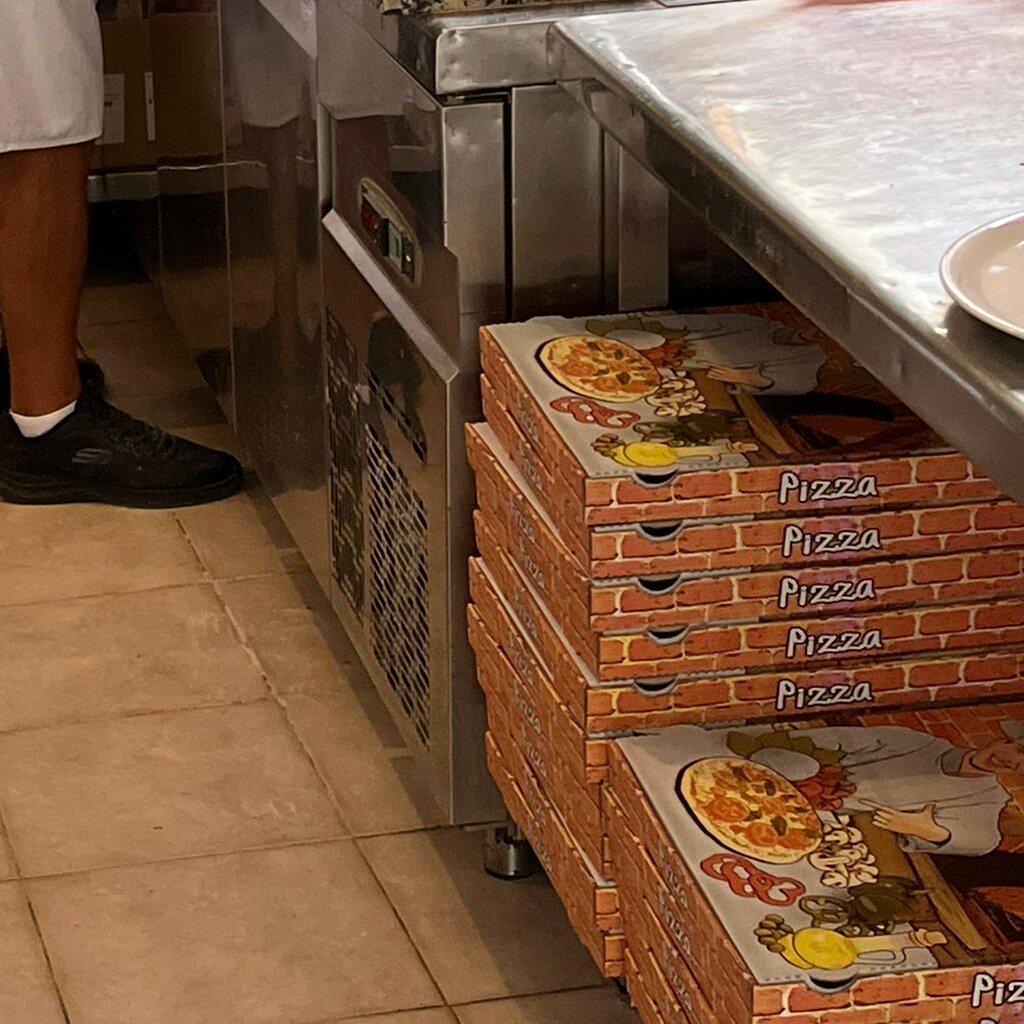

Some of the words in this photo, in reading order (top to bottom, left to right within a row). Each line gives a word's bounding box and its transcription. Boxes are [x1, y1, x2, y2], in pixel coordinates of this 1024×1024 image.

[779, 471, 878, 504] Pizza
[782, 524, 881, 556] Pizza
[779, 576, 875, 608] Pizza
[787, 627, 882, 658] Pizza
[776, 679, 873, 710] Pizza
